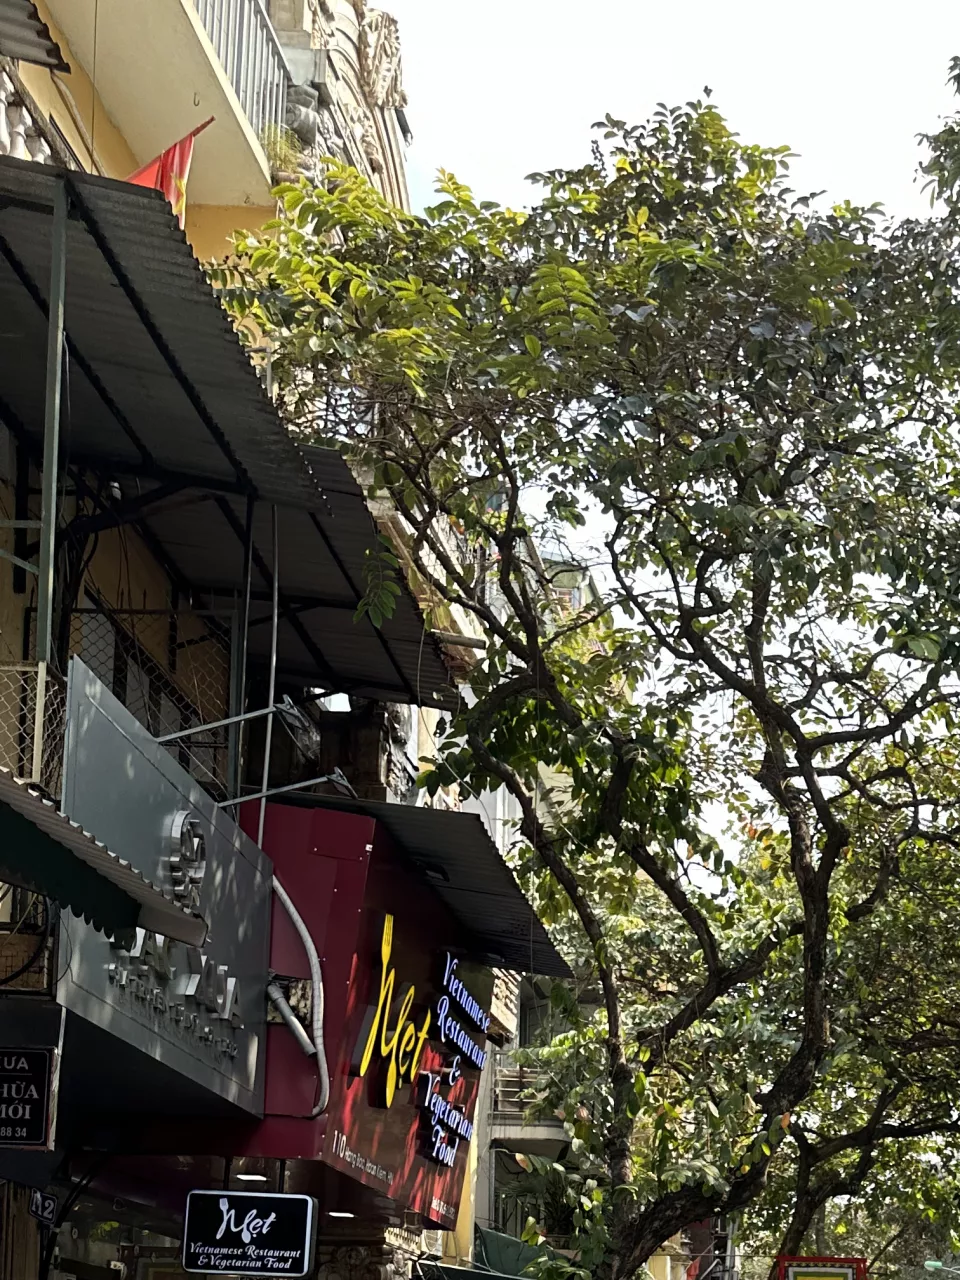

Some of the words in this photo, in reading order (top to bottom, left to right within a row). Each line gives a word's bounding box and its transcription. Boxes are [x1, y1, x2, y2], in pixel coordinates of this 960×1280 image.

[445, 951, 491, 1034] Vietnamese
[437, 995, 487, 1071] Restaurant
[424, 1071, 474, 1142] Vegetarian
[332, 1130, 347, 1159] 110
[432, 1125, 459, 1168] Food
[190, 1242, 243, 1255] Vietnamese
[245, 1244, 301, 1259] Restaurant
[198, 1255, 208, 1266] &
[210, 1255, 262, 1269] Vegetarian
[264, 1257, 292, 1269] Food
